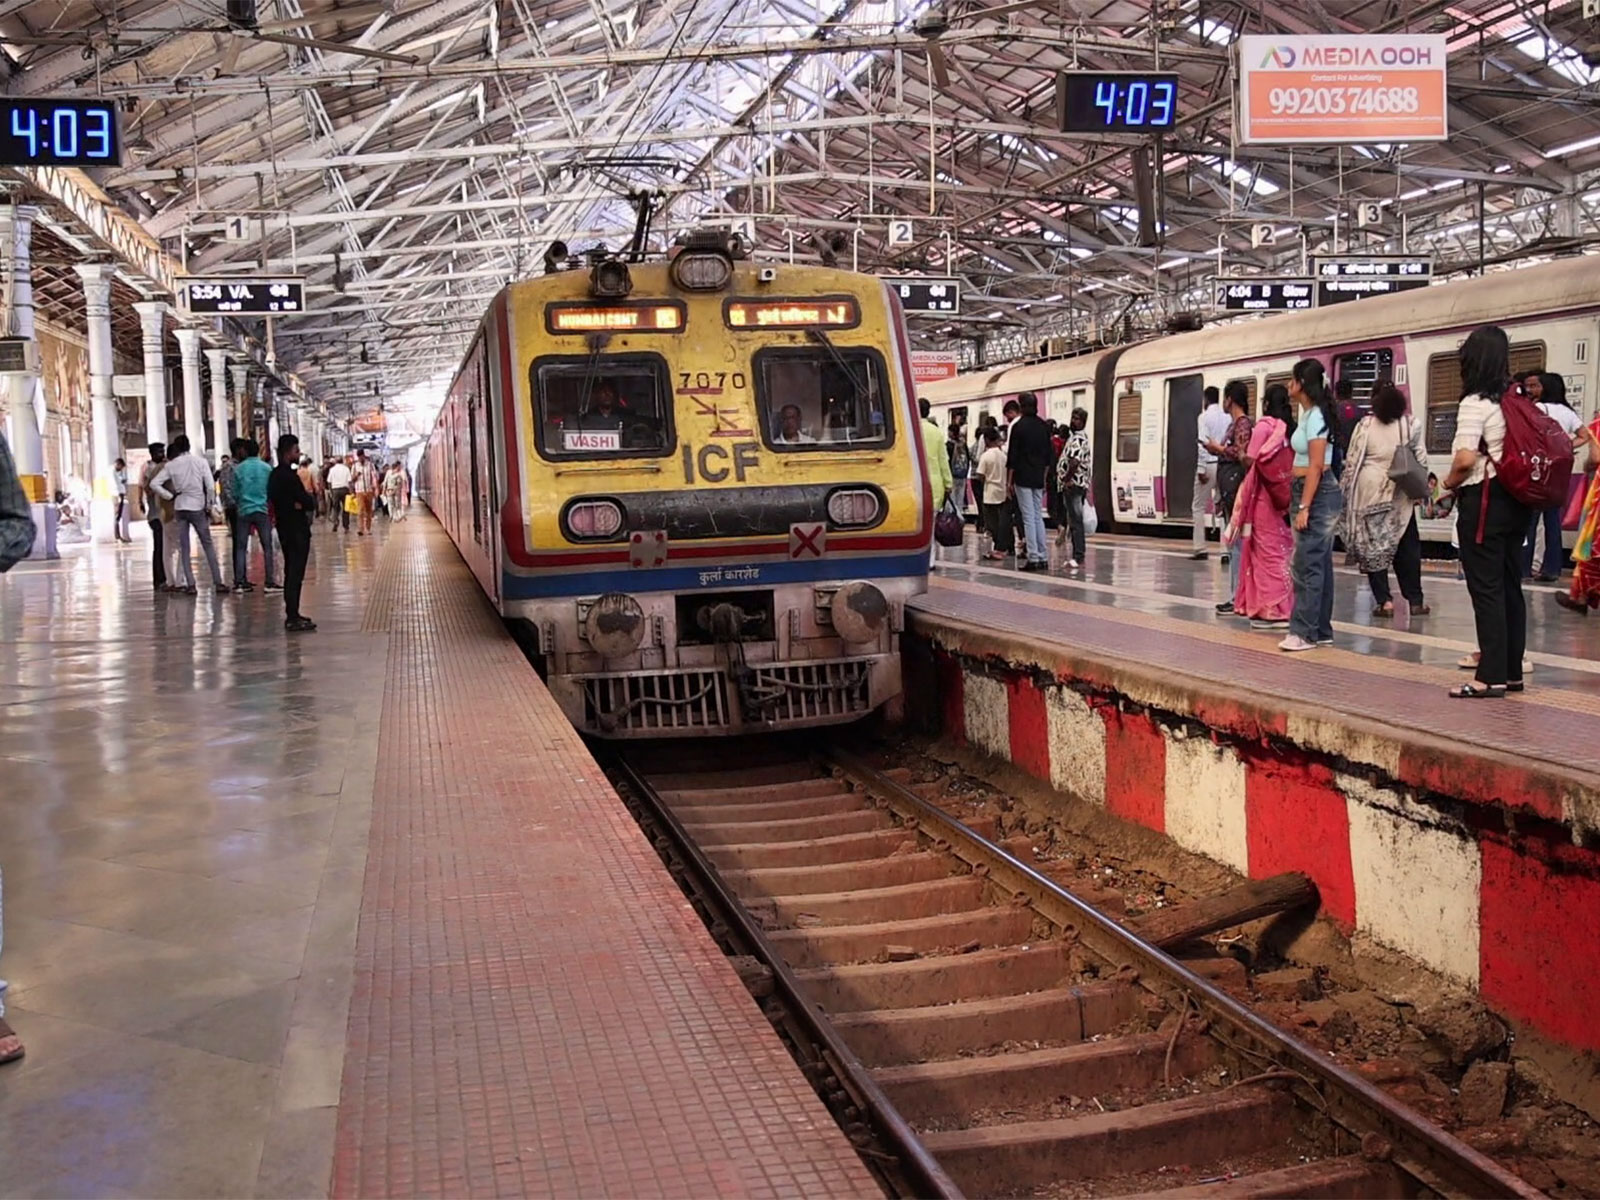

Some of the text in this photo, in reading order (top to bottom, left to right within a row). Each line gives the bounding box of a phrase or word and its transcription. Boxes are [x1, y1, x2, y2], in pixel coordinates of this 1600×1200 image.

[1302, 47, 1378, 65] MEDIA
[1381, 47, 1431, 65] OOH
[1095, 82, 1173, 125] 4:03
[12, 108, 109, 157] 4:03
[1367, 205, 1379, 222] 3
[230, 218, 242, 238] 1
[896, 224, 909, 241] 2
[1260, 226, 1273, 243] 2
[191, 285, 222, 299] 3:54
[900, 285, 910, 297] B
[1217, 287, 1225, 305] 2
[1228, 285, 1309, 297] 4:04 B Slow
[679, 373, 746, 389] 7070
[571, 435, 615, 448] VASHI
[682, 442, 761, 485] ICF
[699, 565, 760, 586] कुर्ला कारशेड
